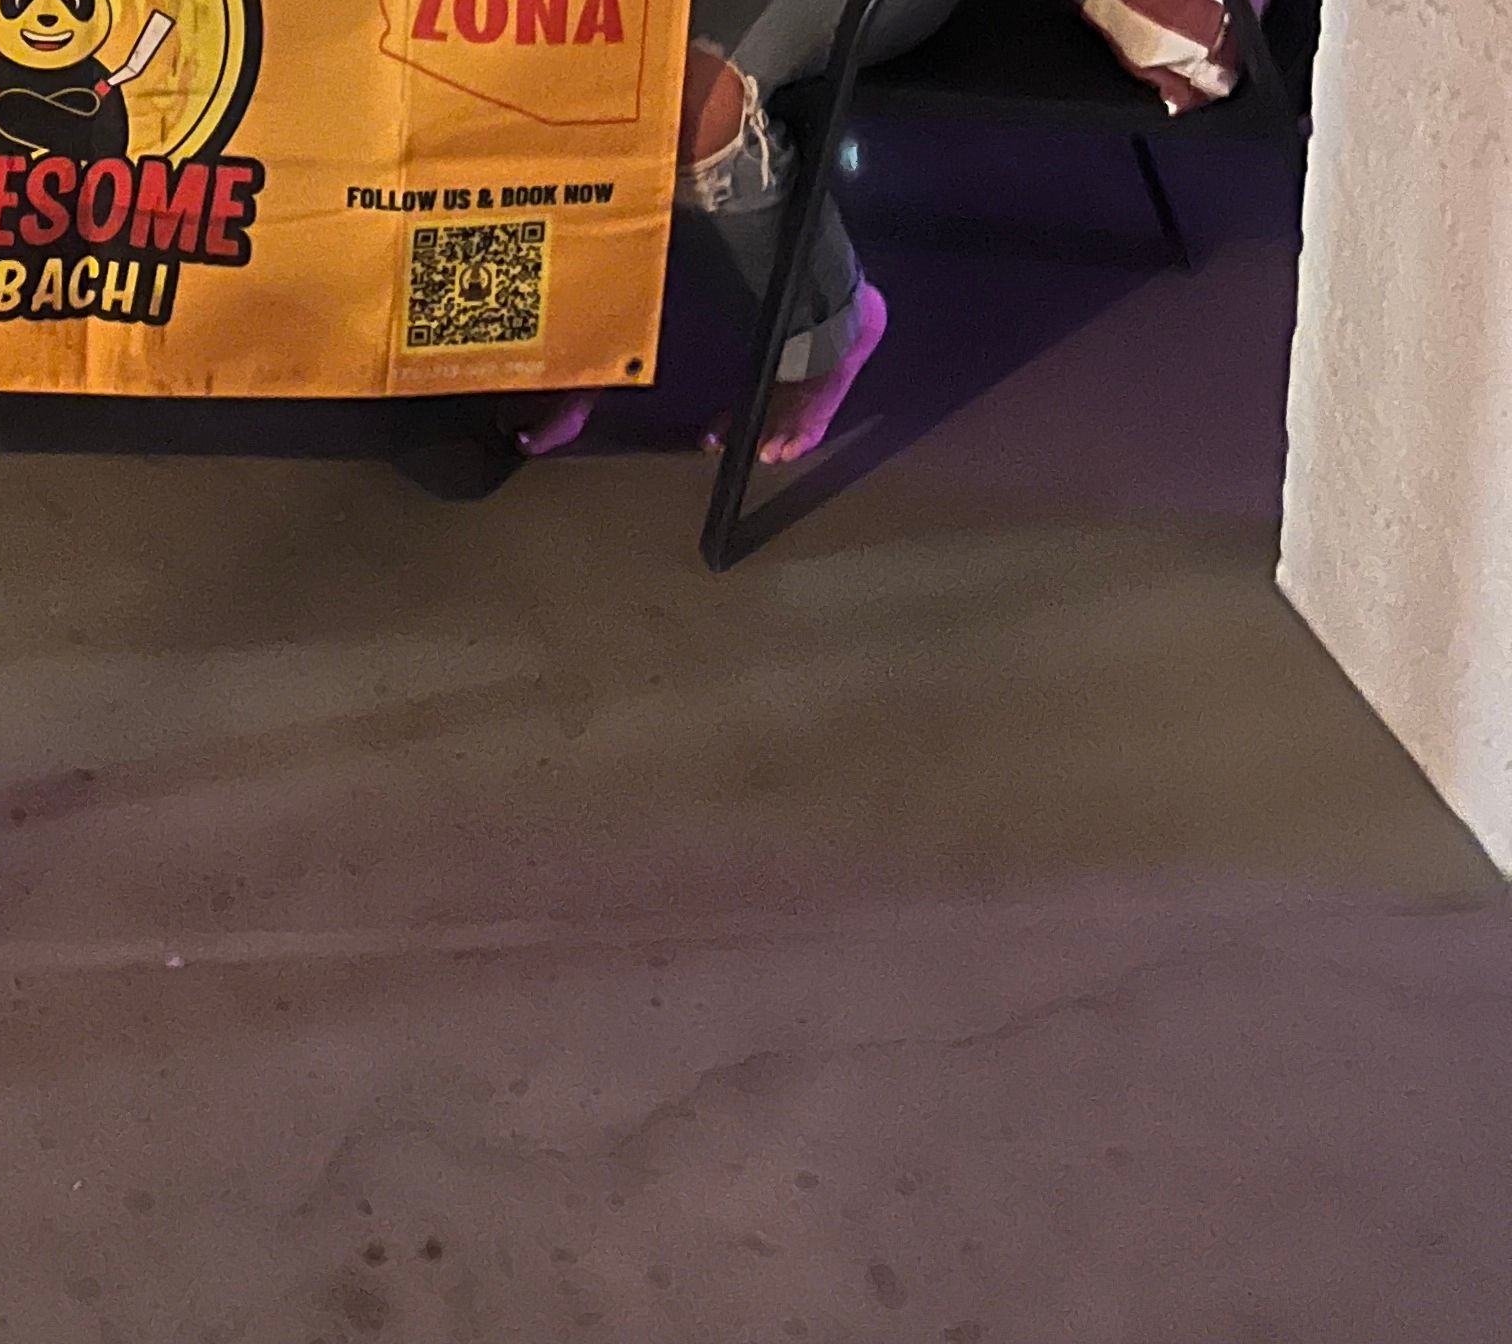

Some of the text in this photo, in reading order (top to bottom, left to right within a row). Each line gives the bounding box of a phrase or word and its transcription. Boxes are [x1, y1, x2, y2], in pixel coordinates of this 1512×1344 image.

[346, 182, 615, 212] FOLLOW US & BOOK NOW
